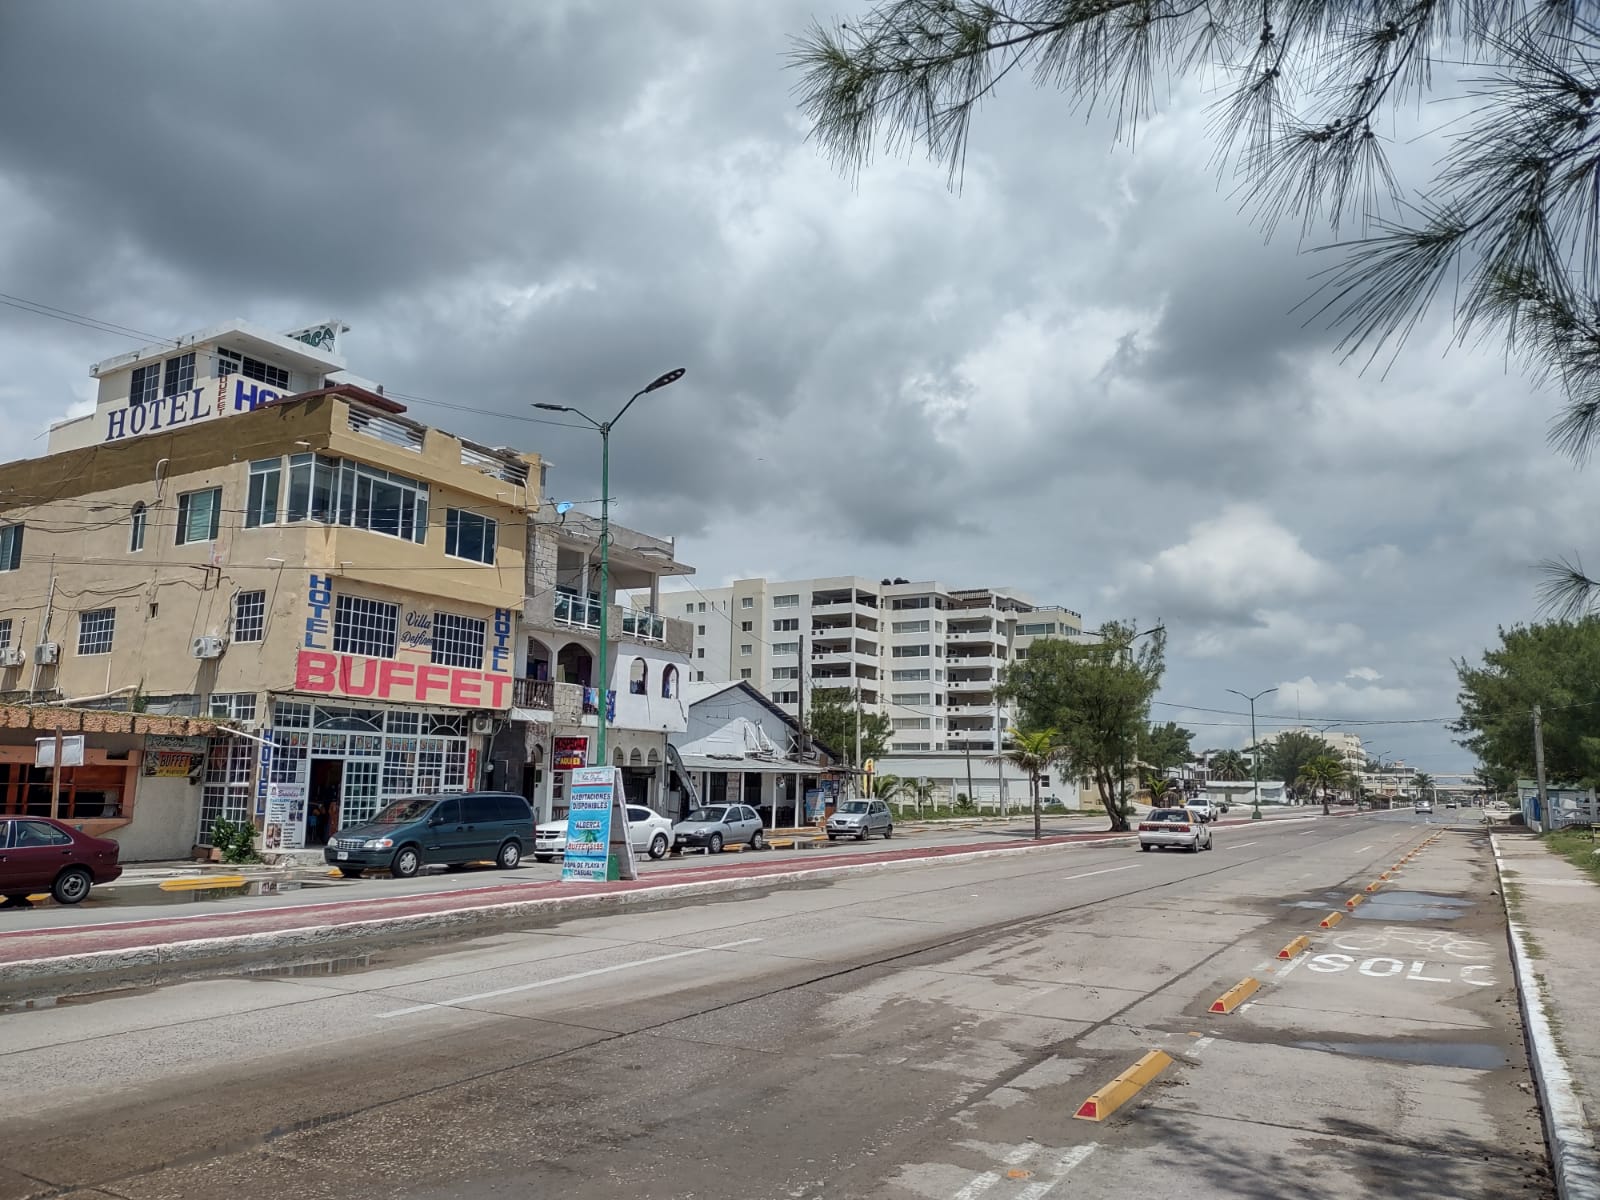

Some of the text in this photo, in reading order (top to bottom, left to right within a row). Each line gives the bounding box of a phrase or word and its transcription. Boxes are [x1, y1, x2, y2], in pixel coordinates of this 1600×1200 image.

[235, 379, 290, 411] HO
[105, 387, 211, 441] HOTEL
[305, 574, 332, 649] HOTEL
[406, 610, 431, 629] Villa
[492, 607, 511, 672] HOTEL
[296, 650, 512, 708] BUFFET
[160, 754, 190, 768] BUFFET
[256, 729, 273, 814] HOTEL
[572, 793, 611, 801] HABITACIONES
[573, 802, 608, 810] DISPONIBLES
[576, 821, 600, 829] ALBERCA
